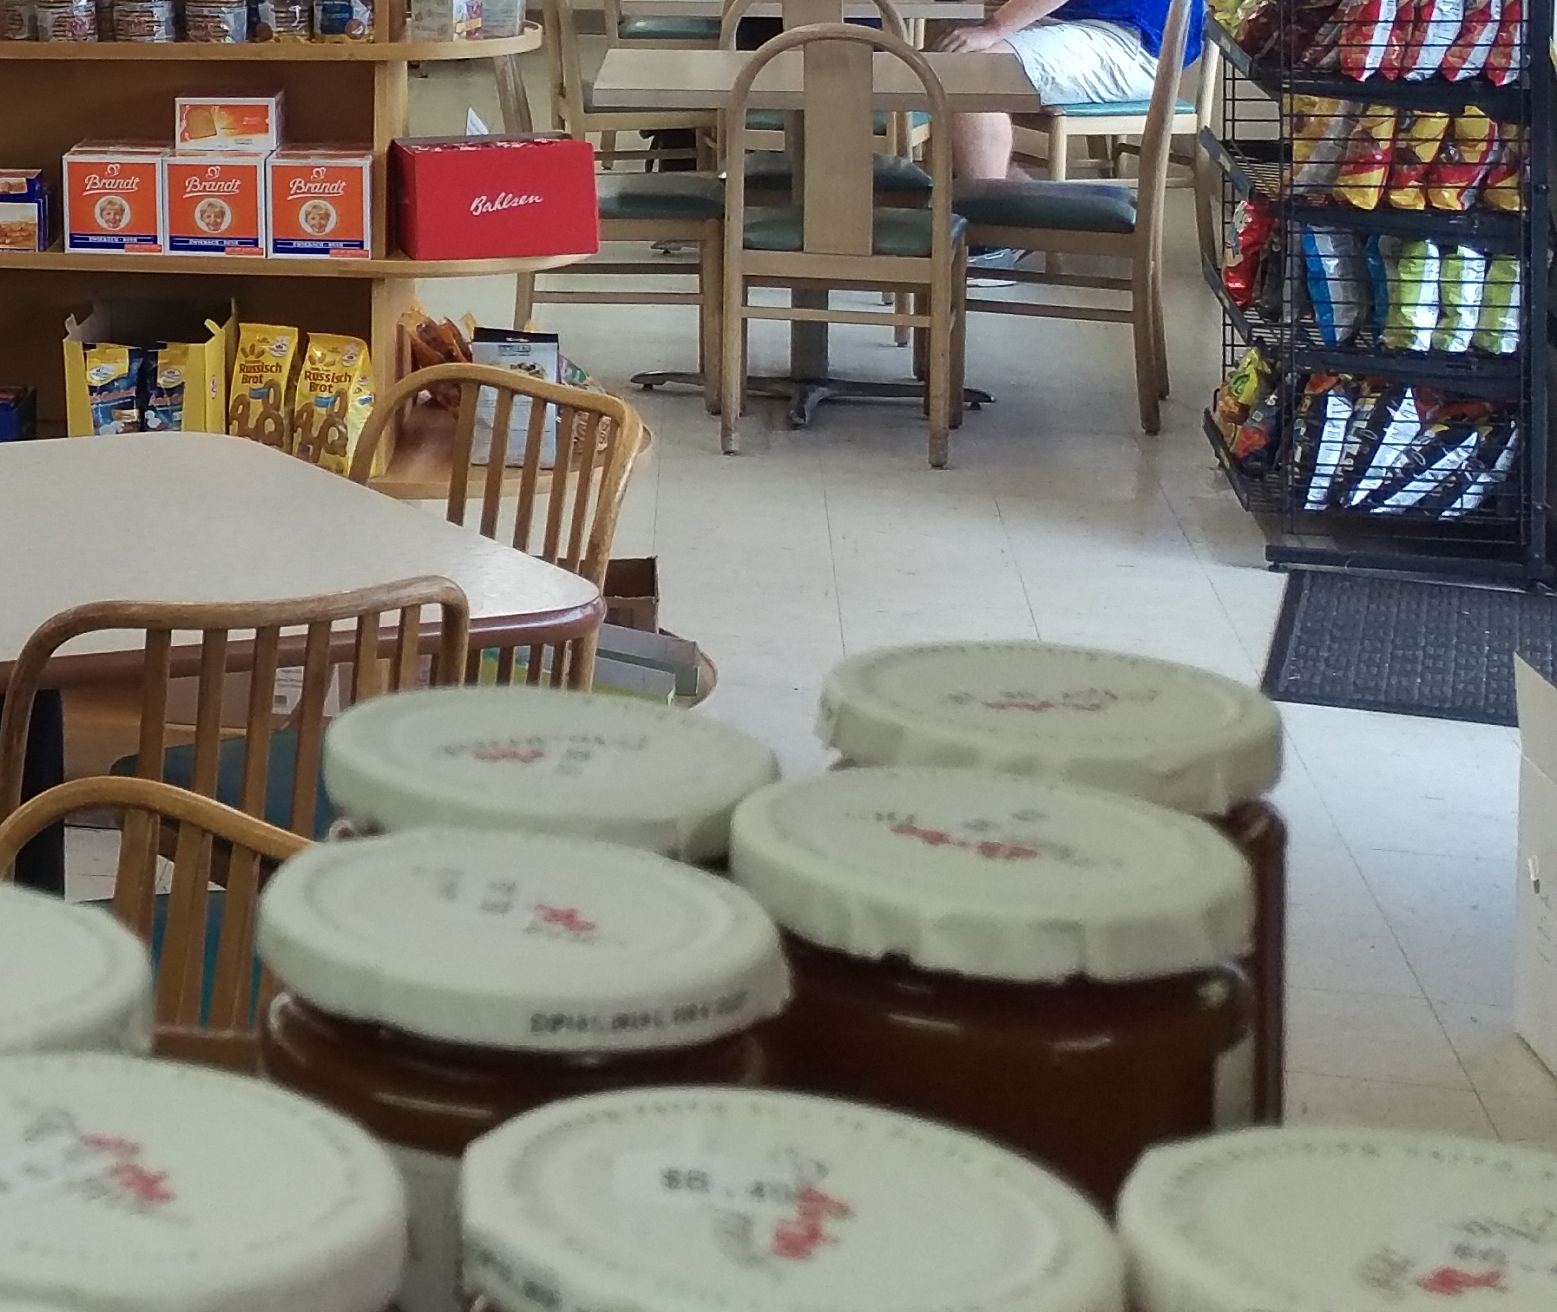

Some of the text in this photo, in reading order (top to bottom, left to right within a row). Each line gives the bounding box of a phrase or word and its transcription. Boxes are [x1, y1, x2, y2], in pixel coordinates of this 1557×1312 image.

[85, 174, 139, 191] Brandt
[186, 176, 241, 193] Brandt
[289, 177, 347, 194] Brandt
[470, 190, 543, 215] Bahlsen
[238, 362, 283, 375] Russisch
[305, 369, 353, 383] Russisch
[240, 374, 264, 384] Brot
[308, 381, 333, 393] Brot
